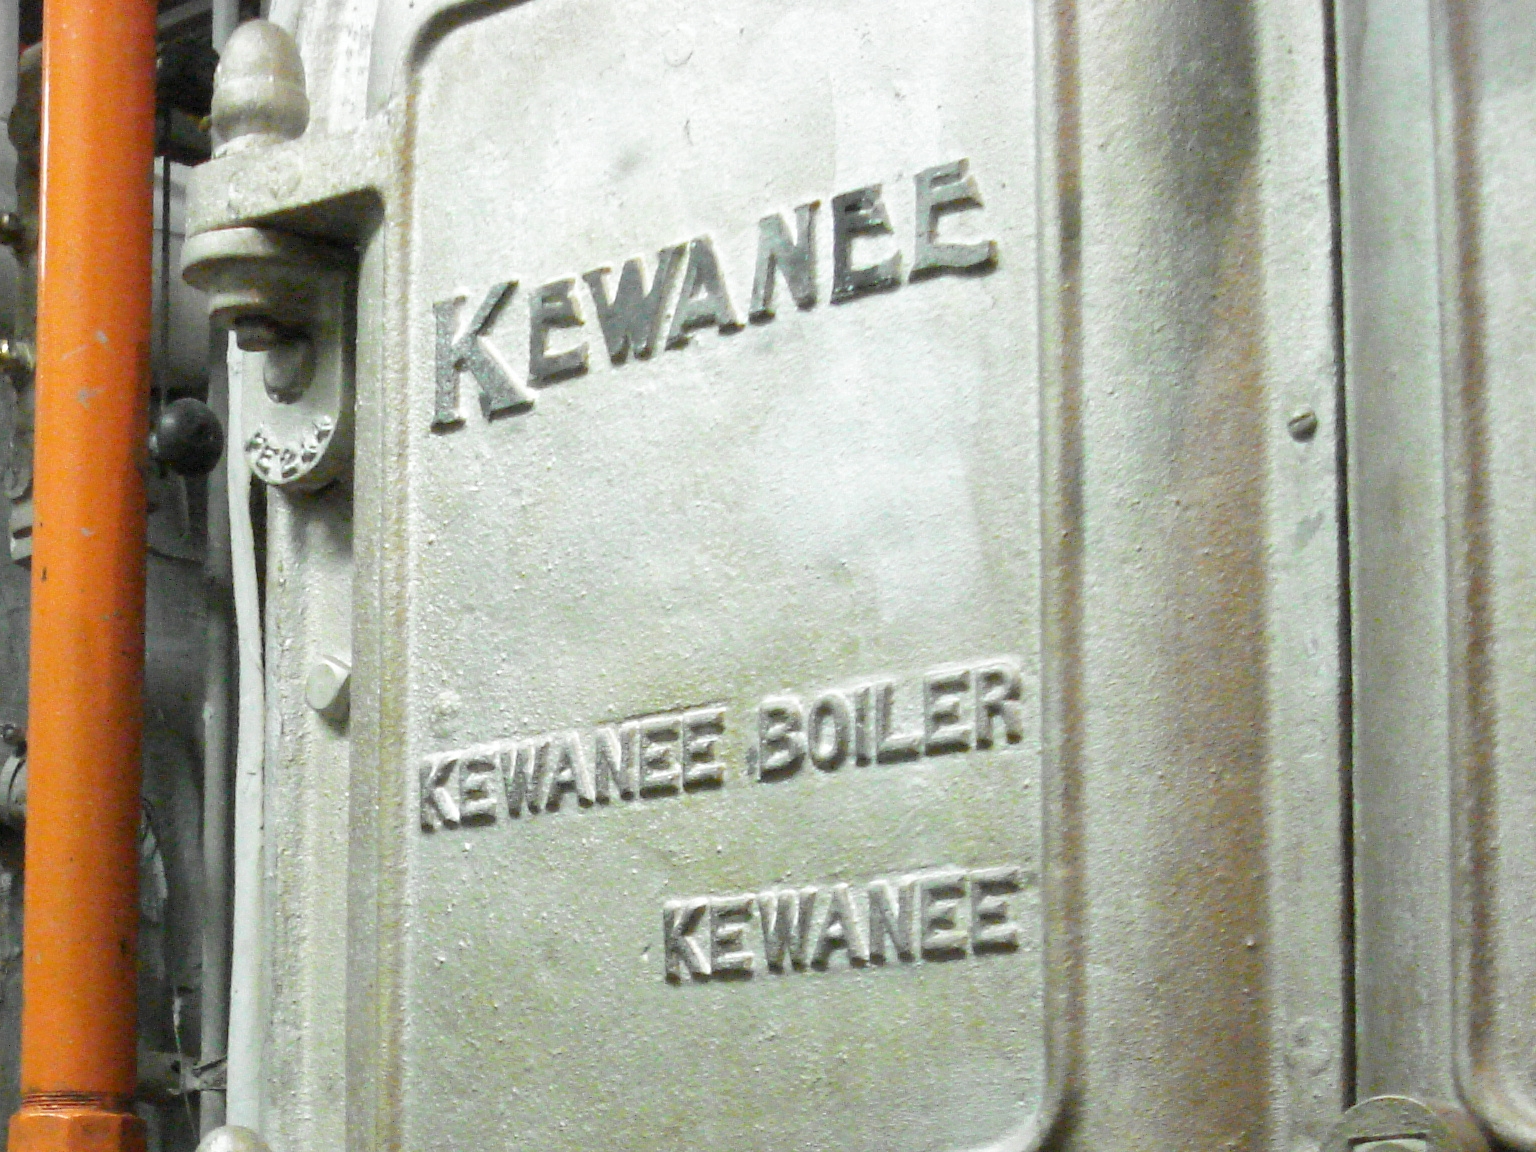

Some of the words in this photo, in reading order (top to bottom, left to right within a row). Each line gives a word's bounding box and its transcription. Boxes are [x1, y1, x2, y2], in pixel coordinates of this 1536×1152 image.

[430, 157, 999, 434] KEWANEE
[419, 704, 728, 833] KEWANEE
[752, 655, 1024, 783] BOILER
[663, 865, 1024, 986] KEWANEE
